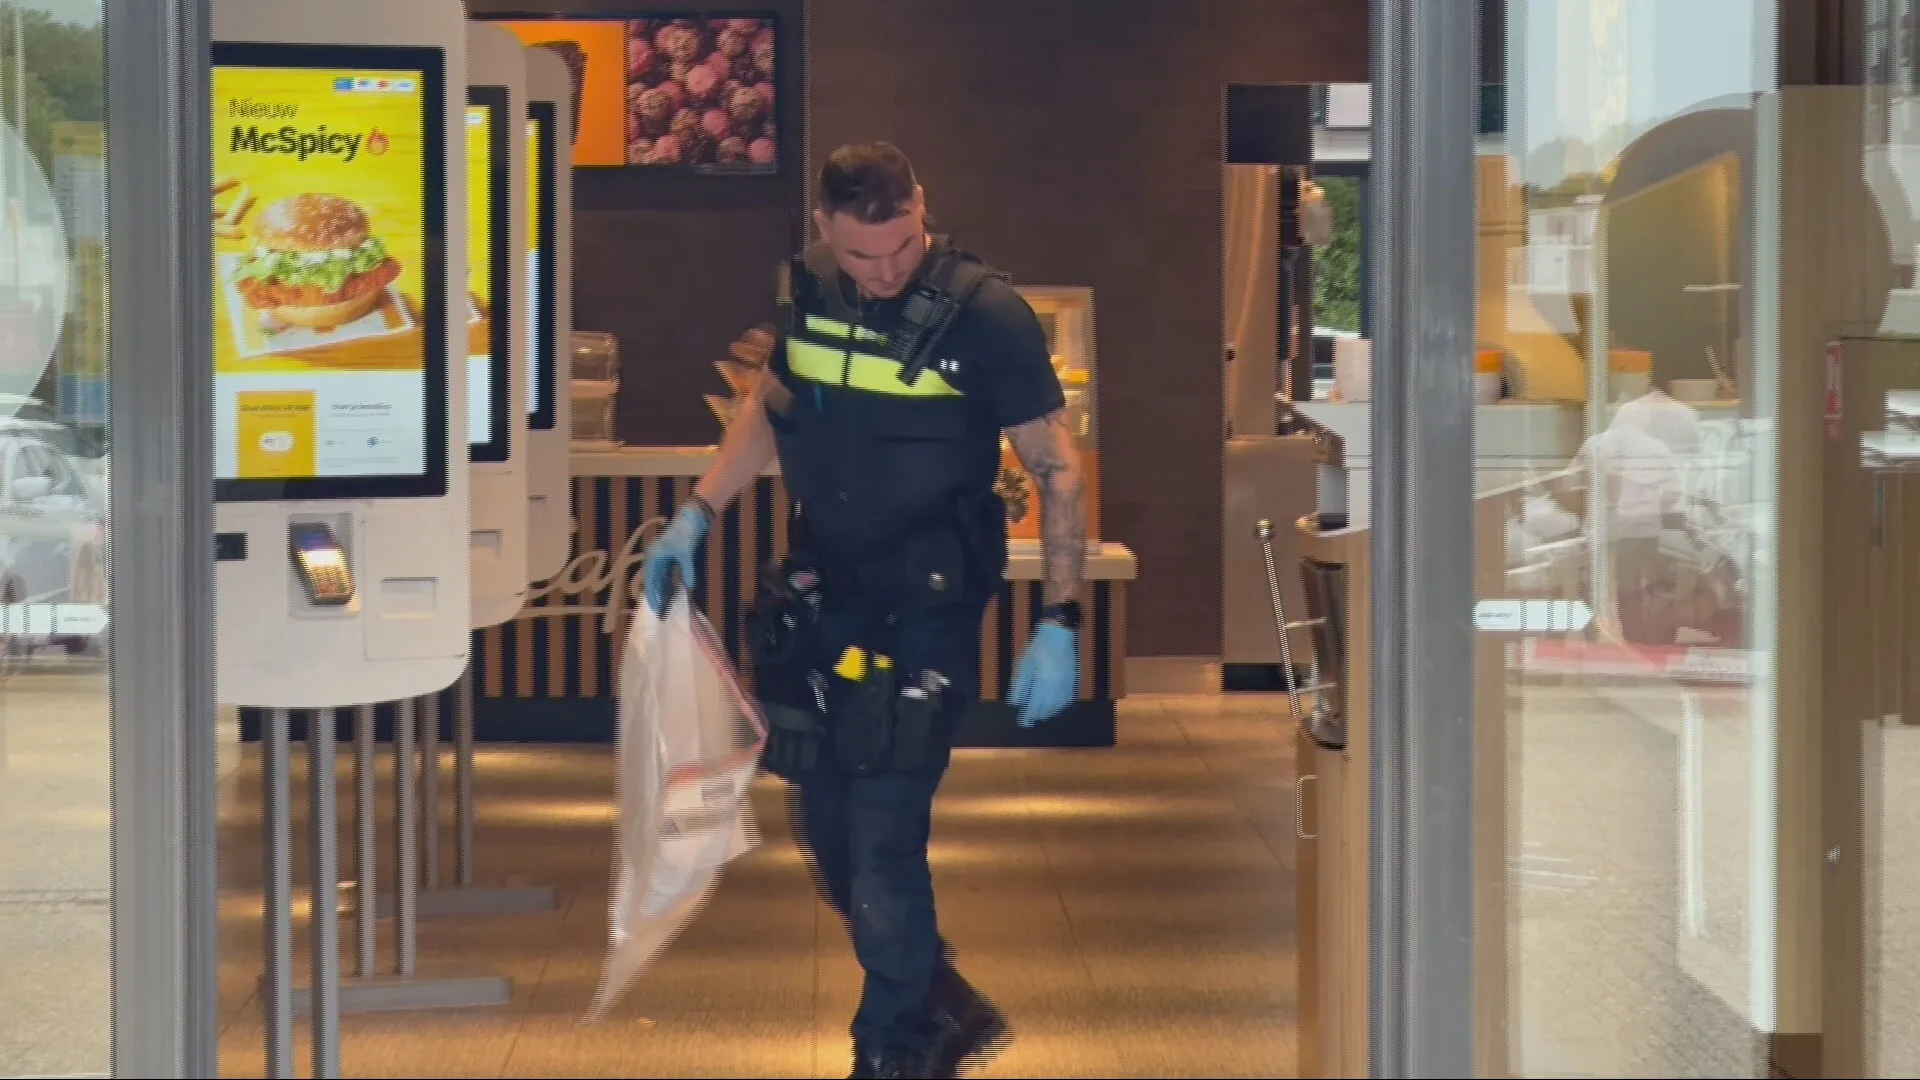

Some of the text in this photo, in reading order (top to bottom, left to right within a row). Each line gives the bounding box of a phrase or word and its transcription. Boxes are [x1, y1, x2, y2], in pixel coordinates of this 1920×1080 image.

[229, 97, 299, 119] Nieuw
[230, 125, 363, 161] McSpicy
[516, 516, 668, 634] af
